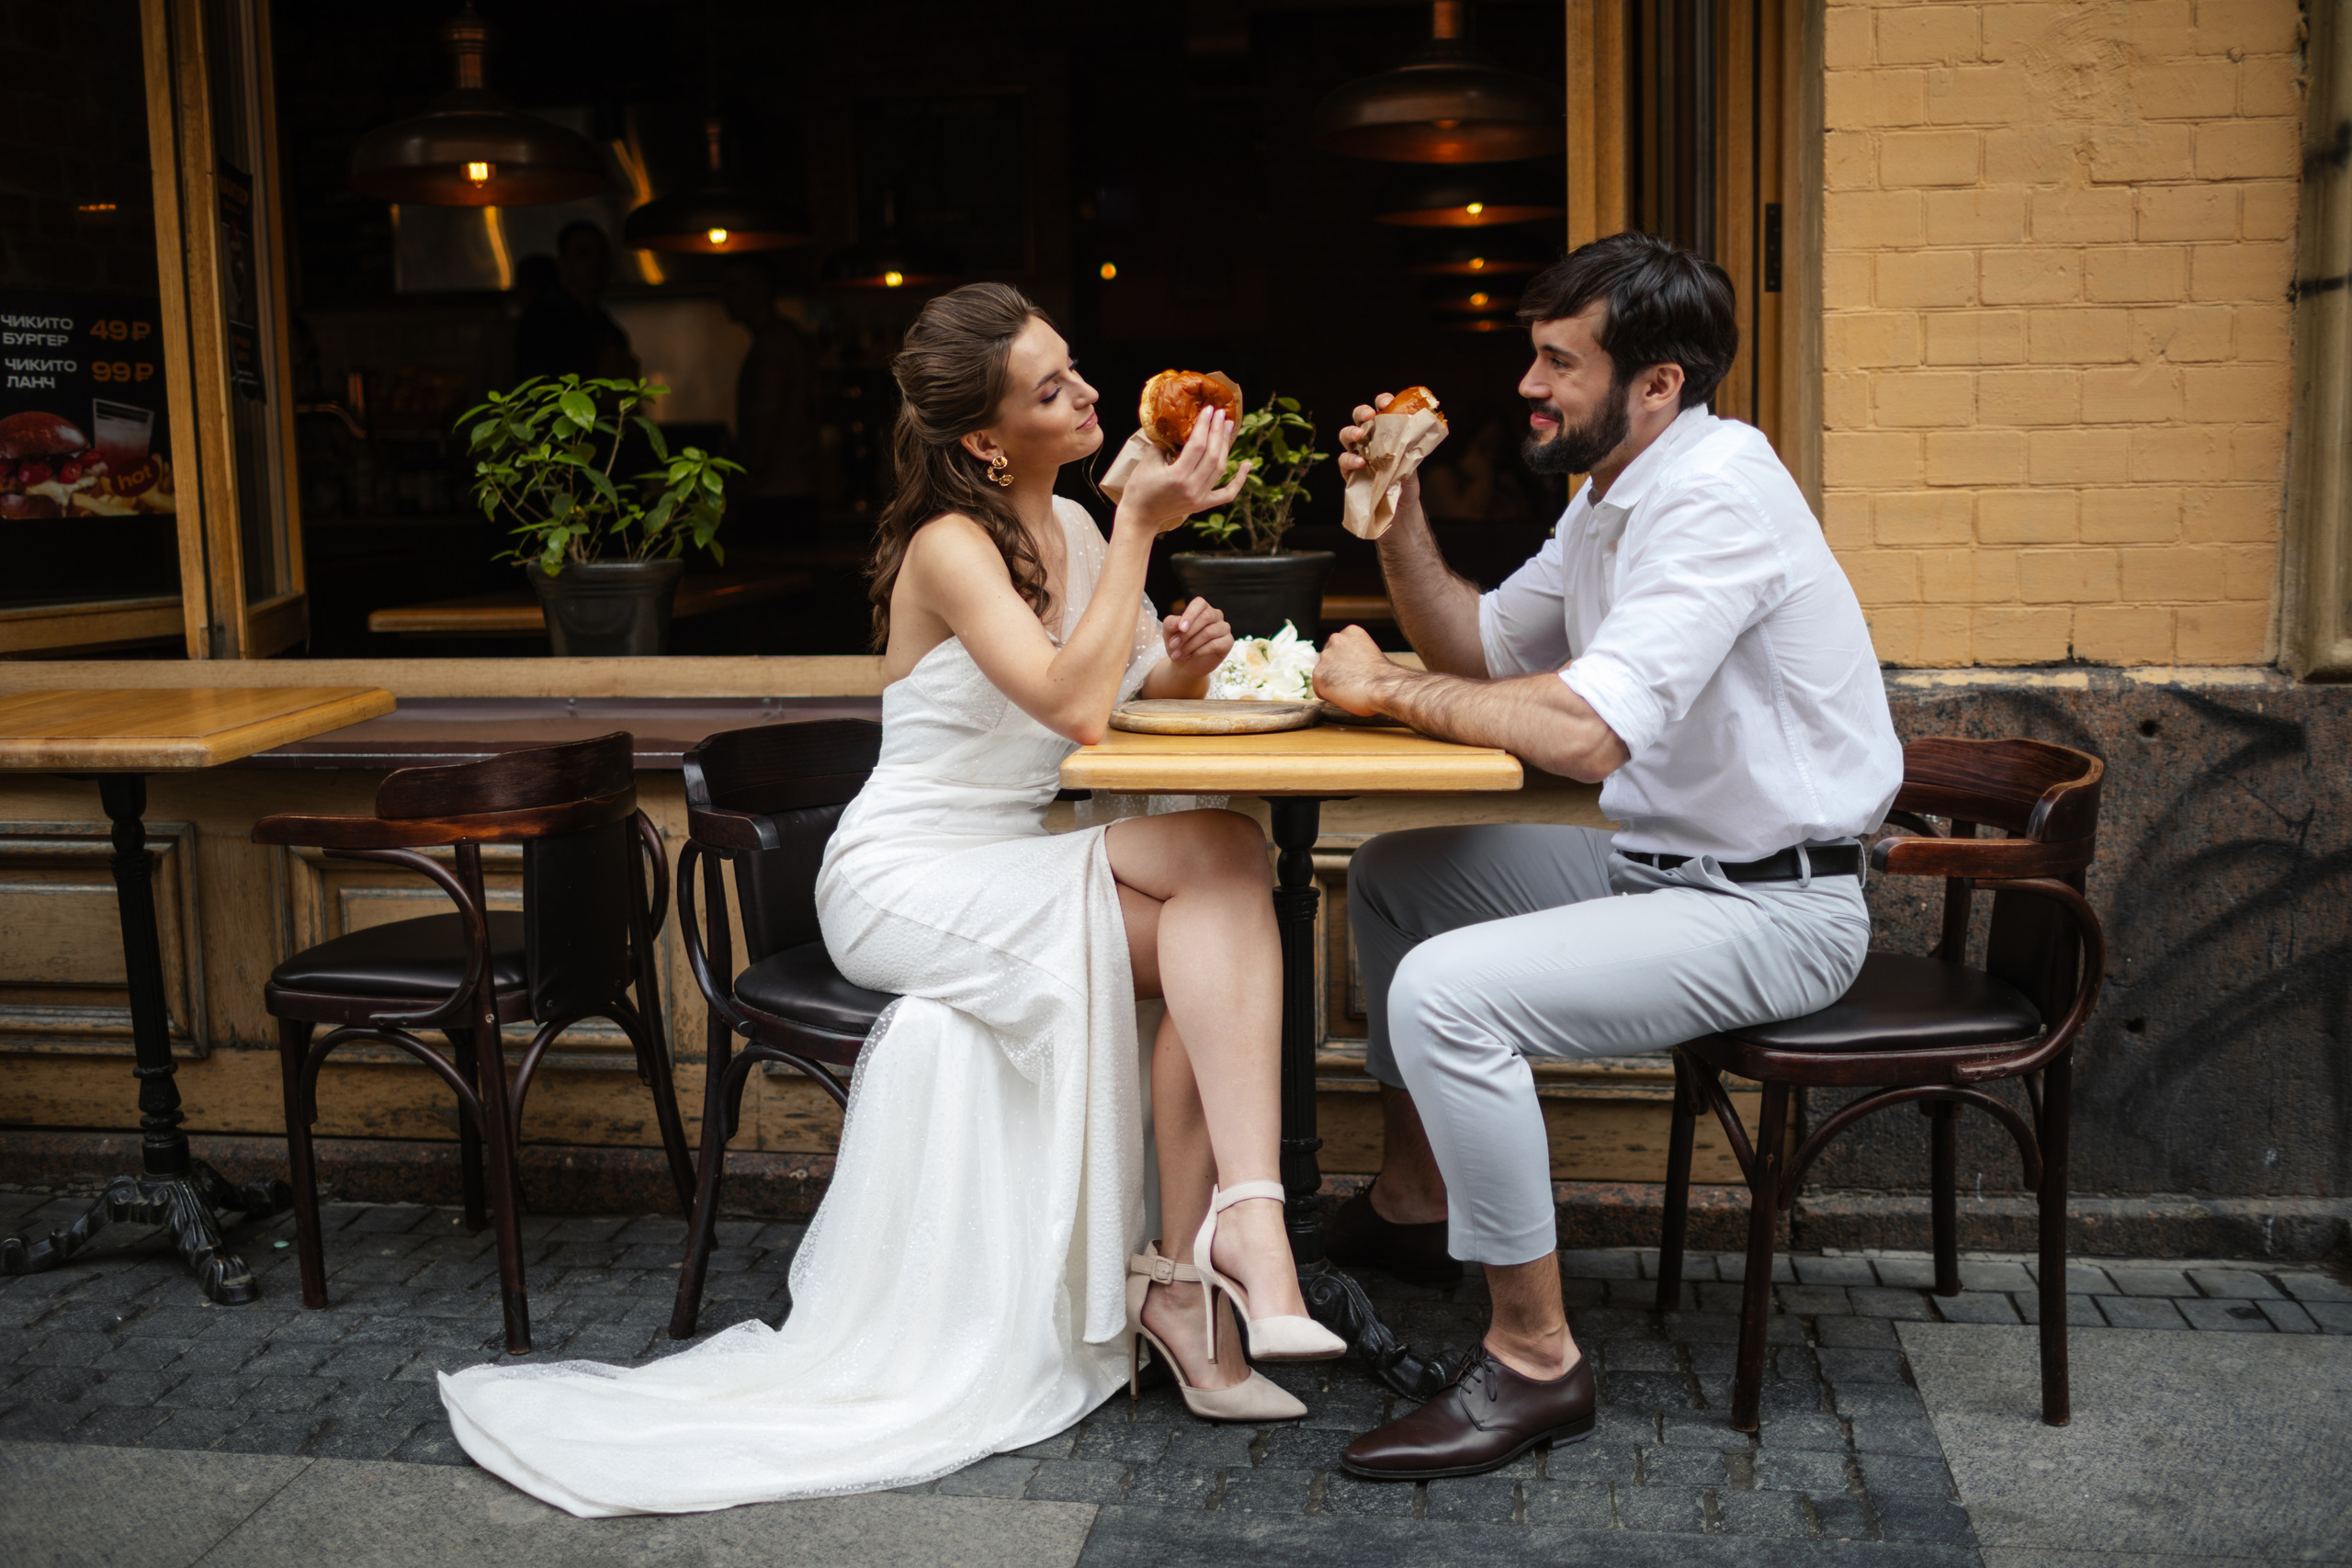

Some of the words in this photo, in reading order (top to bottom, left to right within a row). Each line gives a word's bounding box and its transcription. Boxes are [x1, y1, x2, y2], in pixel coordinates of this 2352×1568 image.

[0, 315, 74, 331] ЧИКИТО
[3, 332, 69, 346] БУРГЕР
[5, 357, 77, 373] ЧИКИТО
[6, 375, 56, 389] ЛАНЧ
[117, 464, 153, 490] hot
